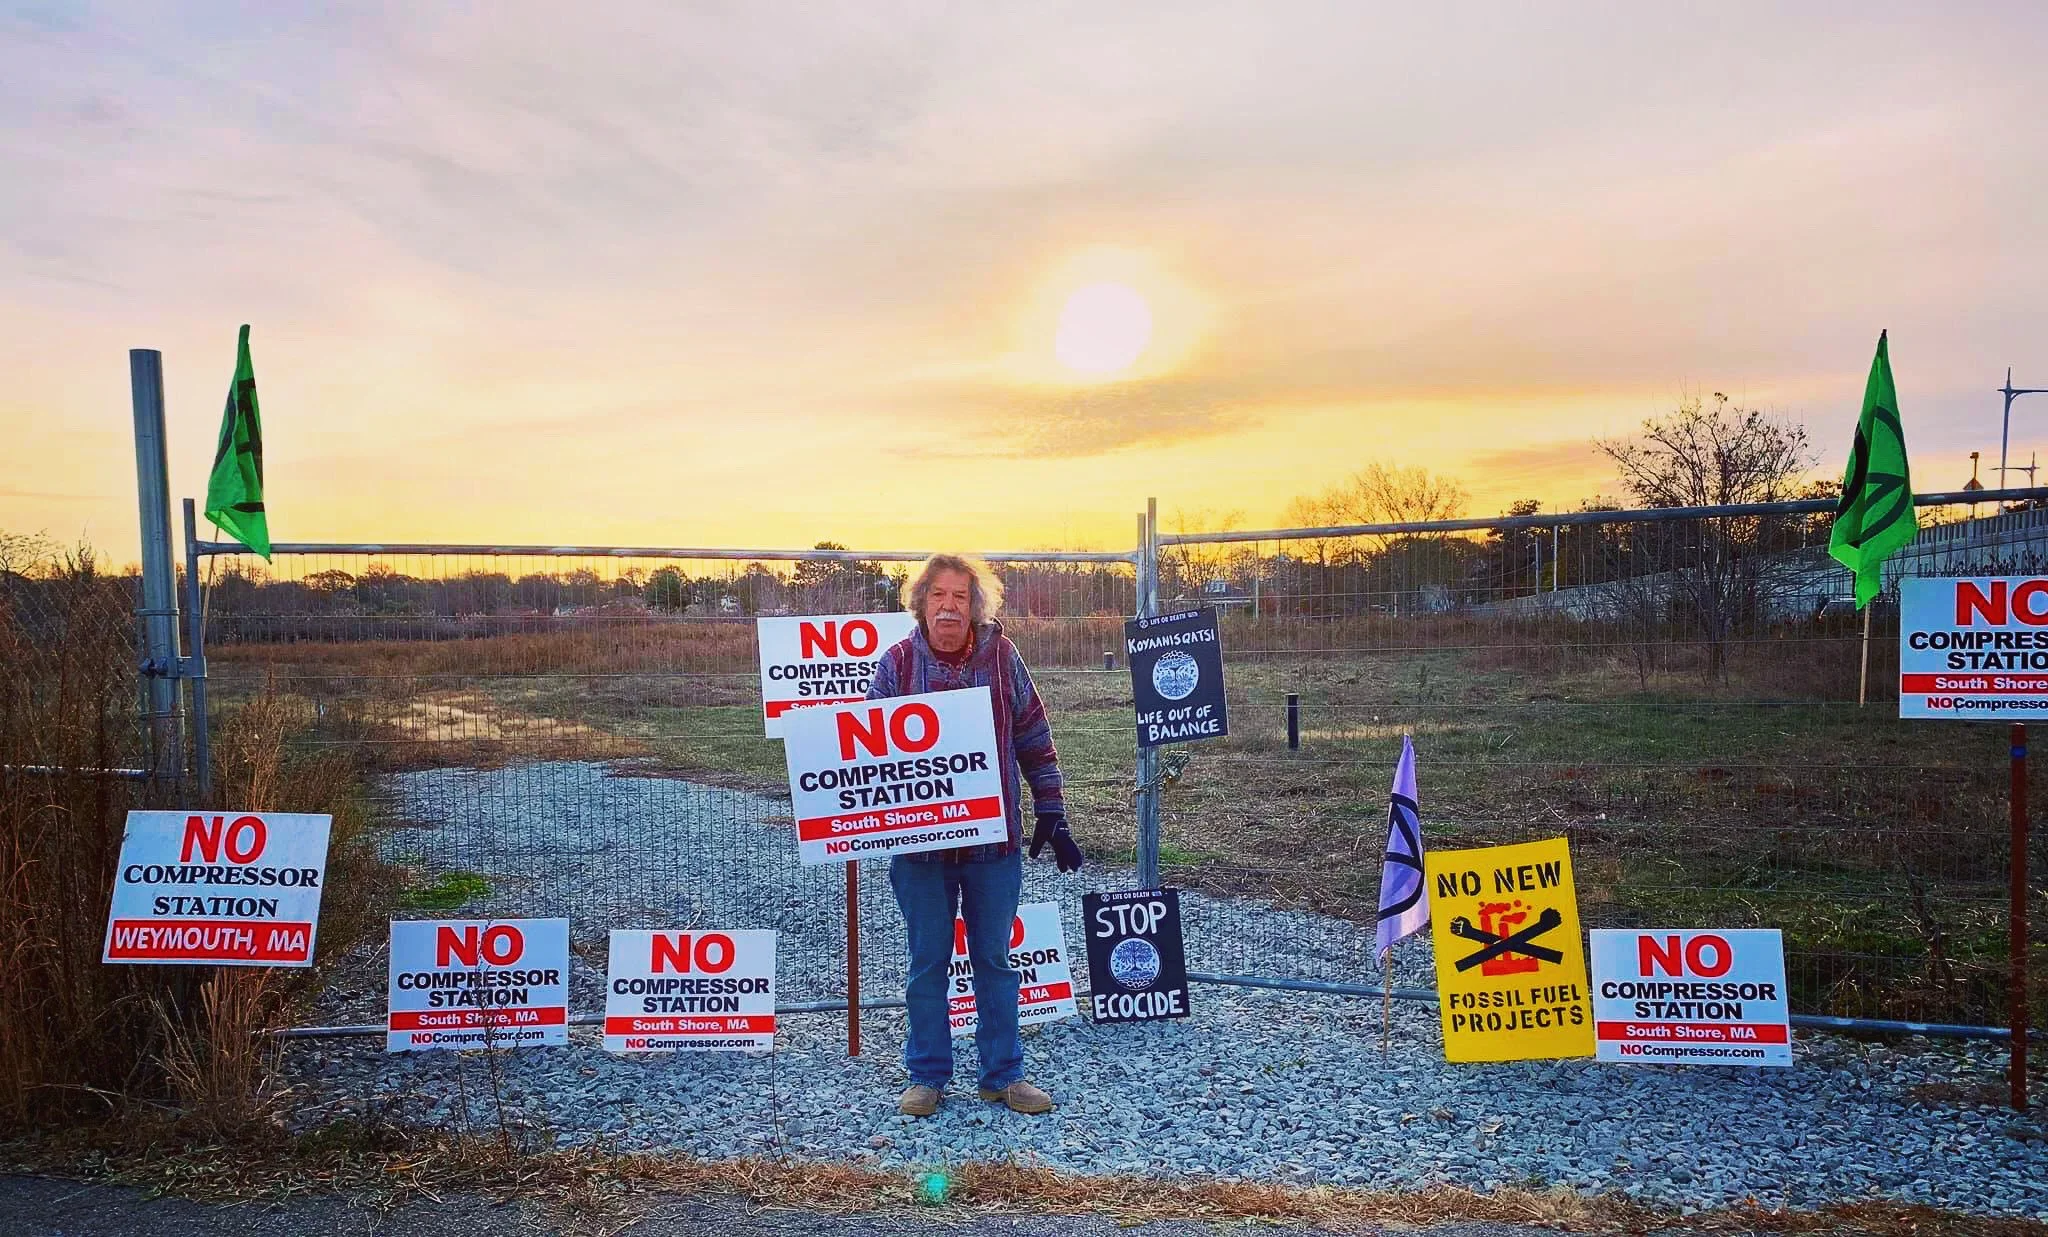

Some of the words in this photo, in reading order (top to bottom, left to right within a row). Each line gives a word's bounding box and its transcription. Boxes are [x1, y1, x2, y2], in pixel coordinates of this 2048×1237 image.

[1956, 580, 2048, 626] NO
[800, 620, 878, 658] NO
[1128, 628, 1214, 654] KOYAANISQATSI
[1909, 631, 2048, 650] COMPRES
[1948, 652, 2048, 670] STATIO
[798, 678, 870, 696] STATIO
[1935, 678, 1988, 689] South
[1994, 678, 2048, 689] Shore
[1138, 710, 1164, 724] LIFE
[1168, 706, 1192, 720] OUT
[1196, 705, 1212, 718] OF
[1928, 698, 2048, 711] NOCompresso
[836, 703, 940, 760] NO
[1148, 718, 1220, 742] BALANCE
[800, 752, 988, 792] COMPRESSOR
[839, 778, 954, 810] STATION
[831, 817, 880, 832] South
[884, 810, 938, 826] Shore,
[943, 804, 970, 819] MA
[180, 816, 267, 864] NO
[826, 826, 979, 854] NOCompressor.com
[124, 865, 319, 888] COMPRESSOR
[1437, 870, 1482, 898] NO
[1494, 860, 1561, 894] NEW
[153, 896, 279, 918] STATION
[1096, 901, 1168, 938] STOP
[115, 928, 257, 954] WEYMOUTH,
[266, 930, 306, 952] MA
[436, 925, 524, 966] NO
[651, 934, 734, 974] NO
[1638, 935, 1732, 978] NO
[398, 970, 560, 990] COMPRESSOR
[614, 978, 770, 995] COMPRESSOR
[1601, 982, 1777, 1000] COMPRESSOR
[428, 988, 528, 1007] STATION
[643, 996, 739, 1013] STATION
[1030, 988, 1050, 999] MA
[1450, 990, 1524, 1009] FOSSIL
[1531, 984, 1581, 1004] FUEL
[1094, 990, 1184, 1020] ECOCIDE
[1635, 1002, 1742, 1019] STATION
[418, 1014, 460, 1026] South
[516, 1011, 538, 1022] MA
[633, 1020, 674, 1030] South
[678, 1020, 722, 1032] Shore,
[728, 1020, 749, 1030] MA
[1452, 1005, 1584, 1032] PROJECTS
[412, 1030, 544, 1044] NOCompresor.com
[626, 1038, 754, 1050] NOCompressor.com
[1626, 1026, 1670, 1038] South
[1675, 1026, 1726, 1040] Shore,
[1730, 1028, 1756, 1039] MA
[1620, 1044, 1764, 1058] NOCompressor.com
